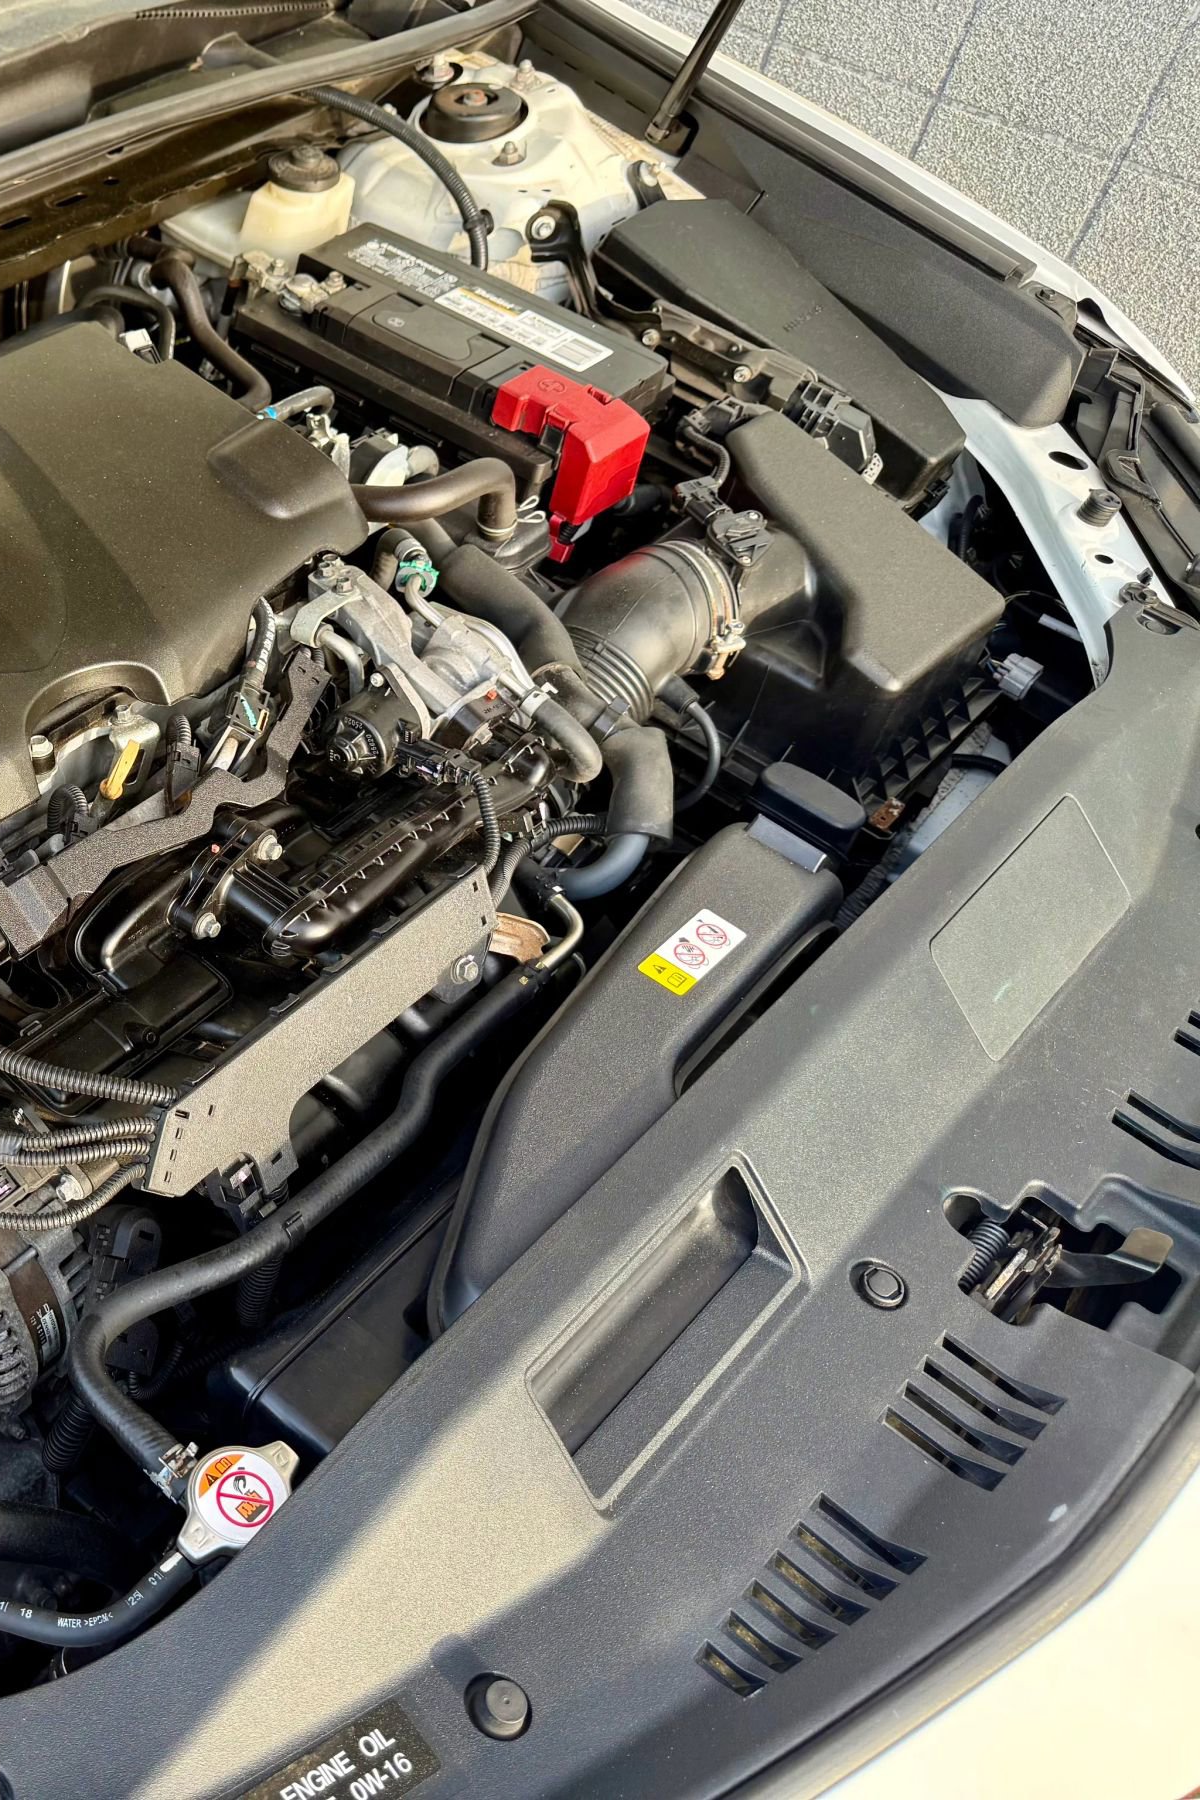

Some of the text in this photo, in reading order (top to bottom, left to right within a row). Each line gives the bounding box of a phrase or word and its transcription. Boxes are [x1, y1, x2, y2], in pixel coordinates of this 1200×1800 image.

[19, 1608, 33, 1619] 18
[57, 1616, 82, 1629] WATER
[279, 1728, 396, 1800] ENGINE OIL
[349, 1752, 412, 1800] 0W-16
